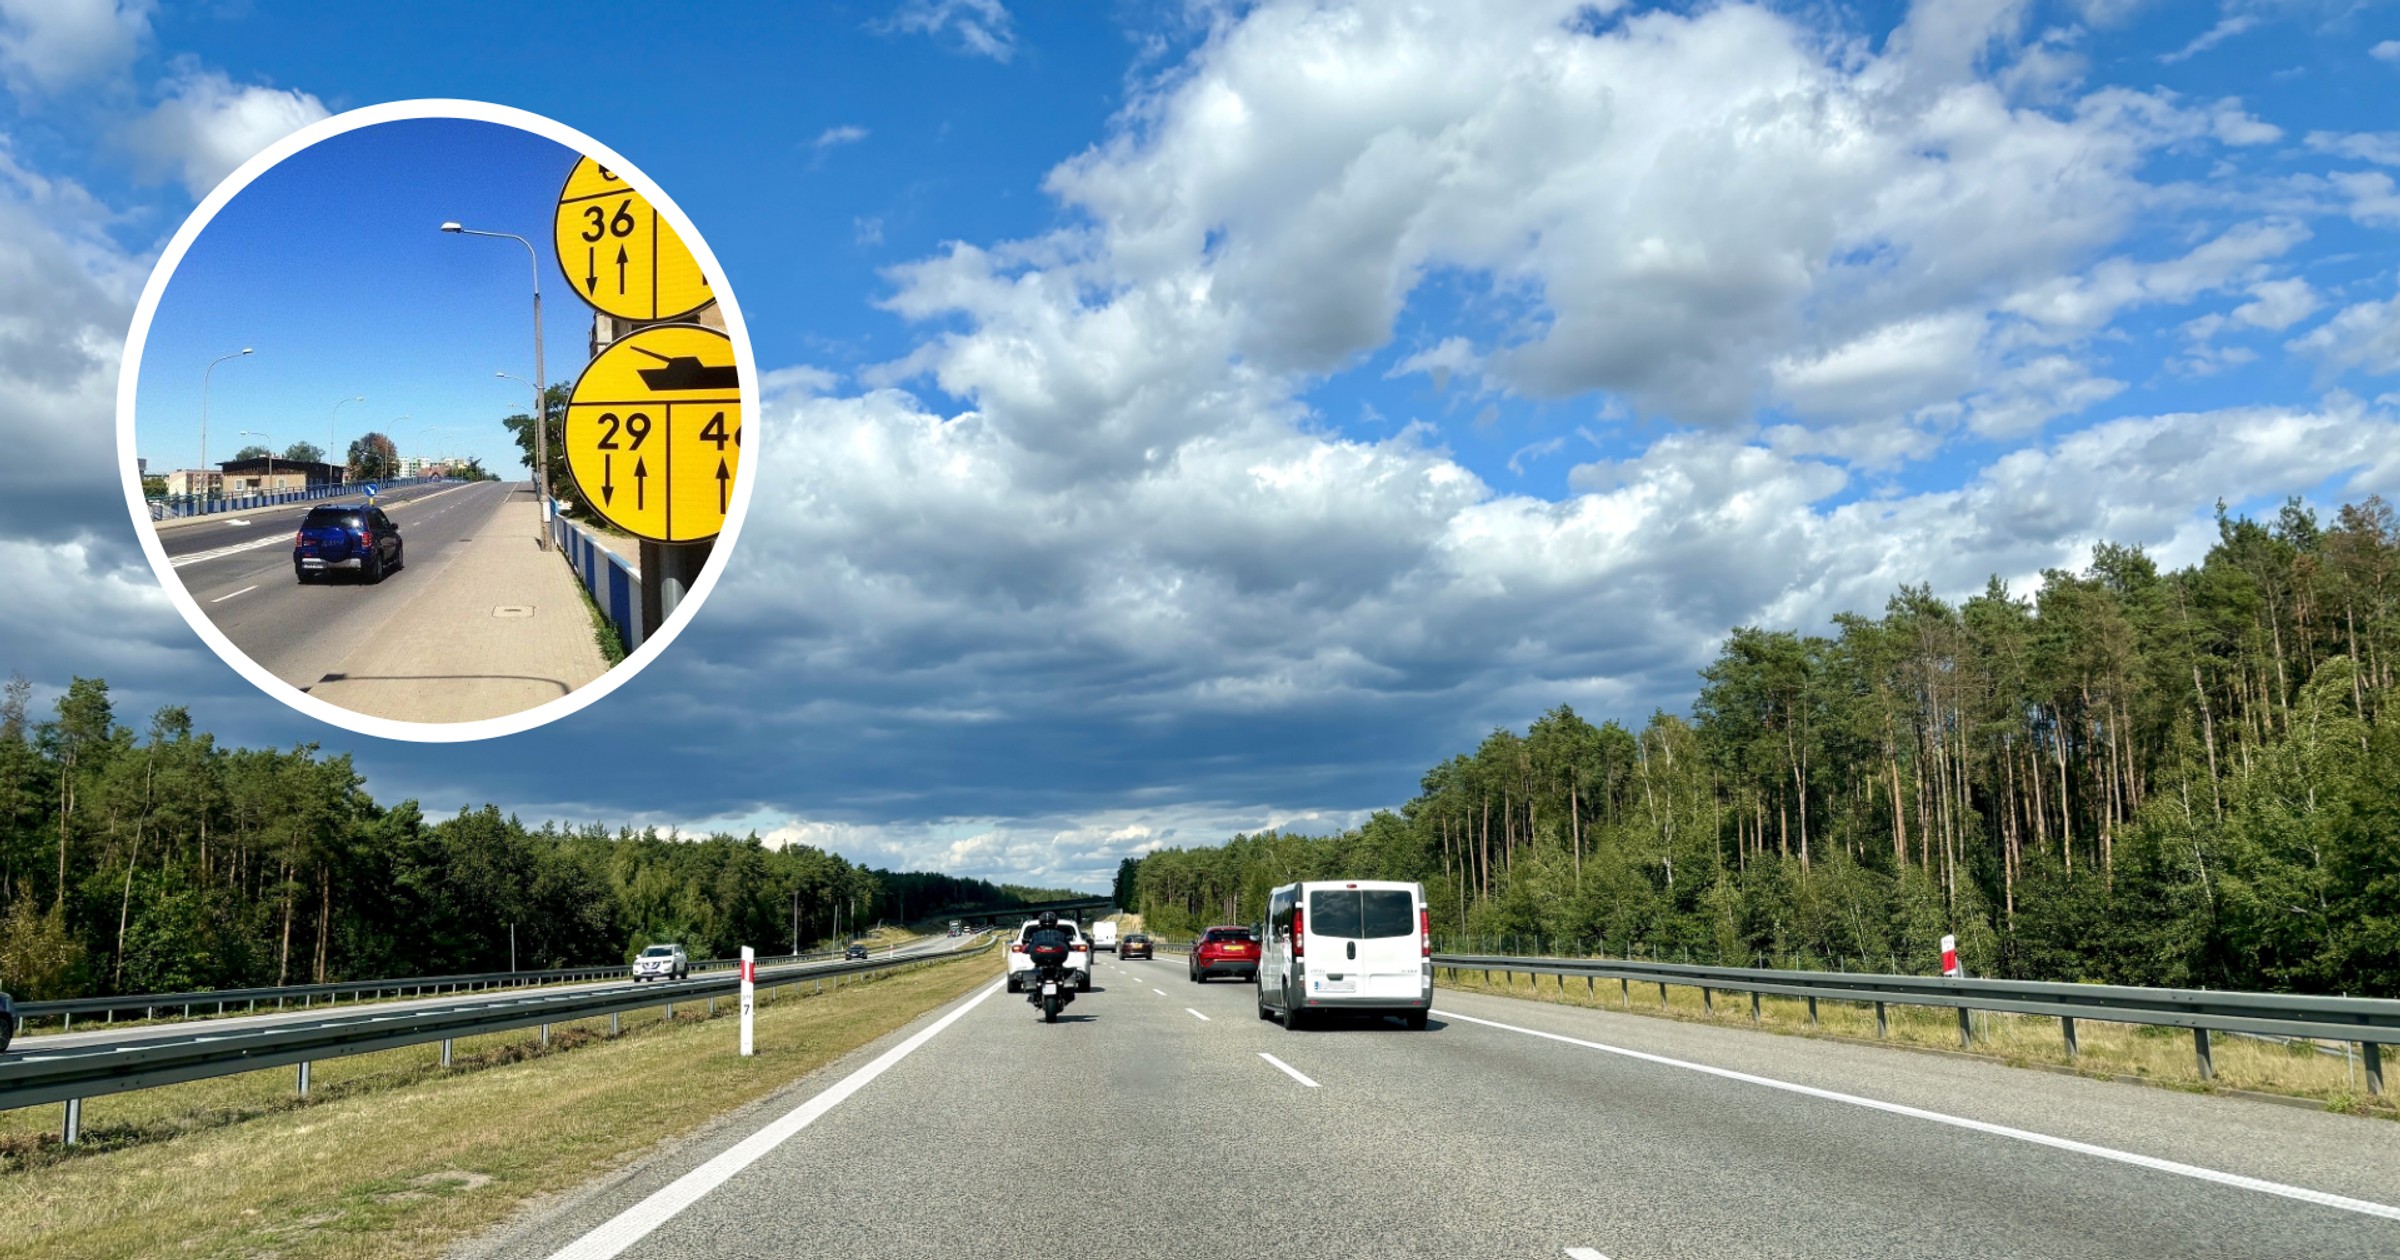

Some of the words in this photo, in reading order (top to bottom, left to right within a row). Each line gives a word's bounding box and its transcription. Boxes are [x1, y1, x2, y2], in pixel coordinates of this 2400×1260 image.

[581, 199, 635, 243] 36
[597, 412, 652, 451] 29
[699, 411, 742, 451] 4
[743, 1003, 750, 1015] 7
